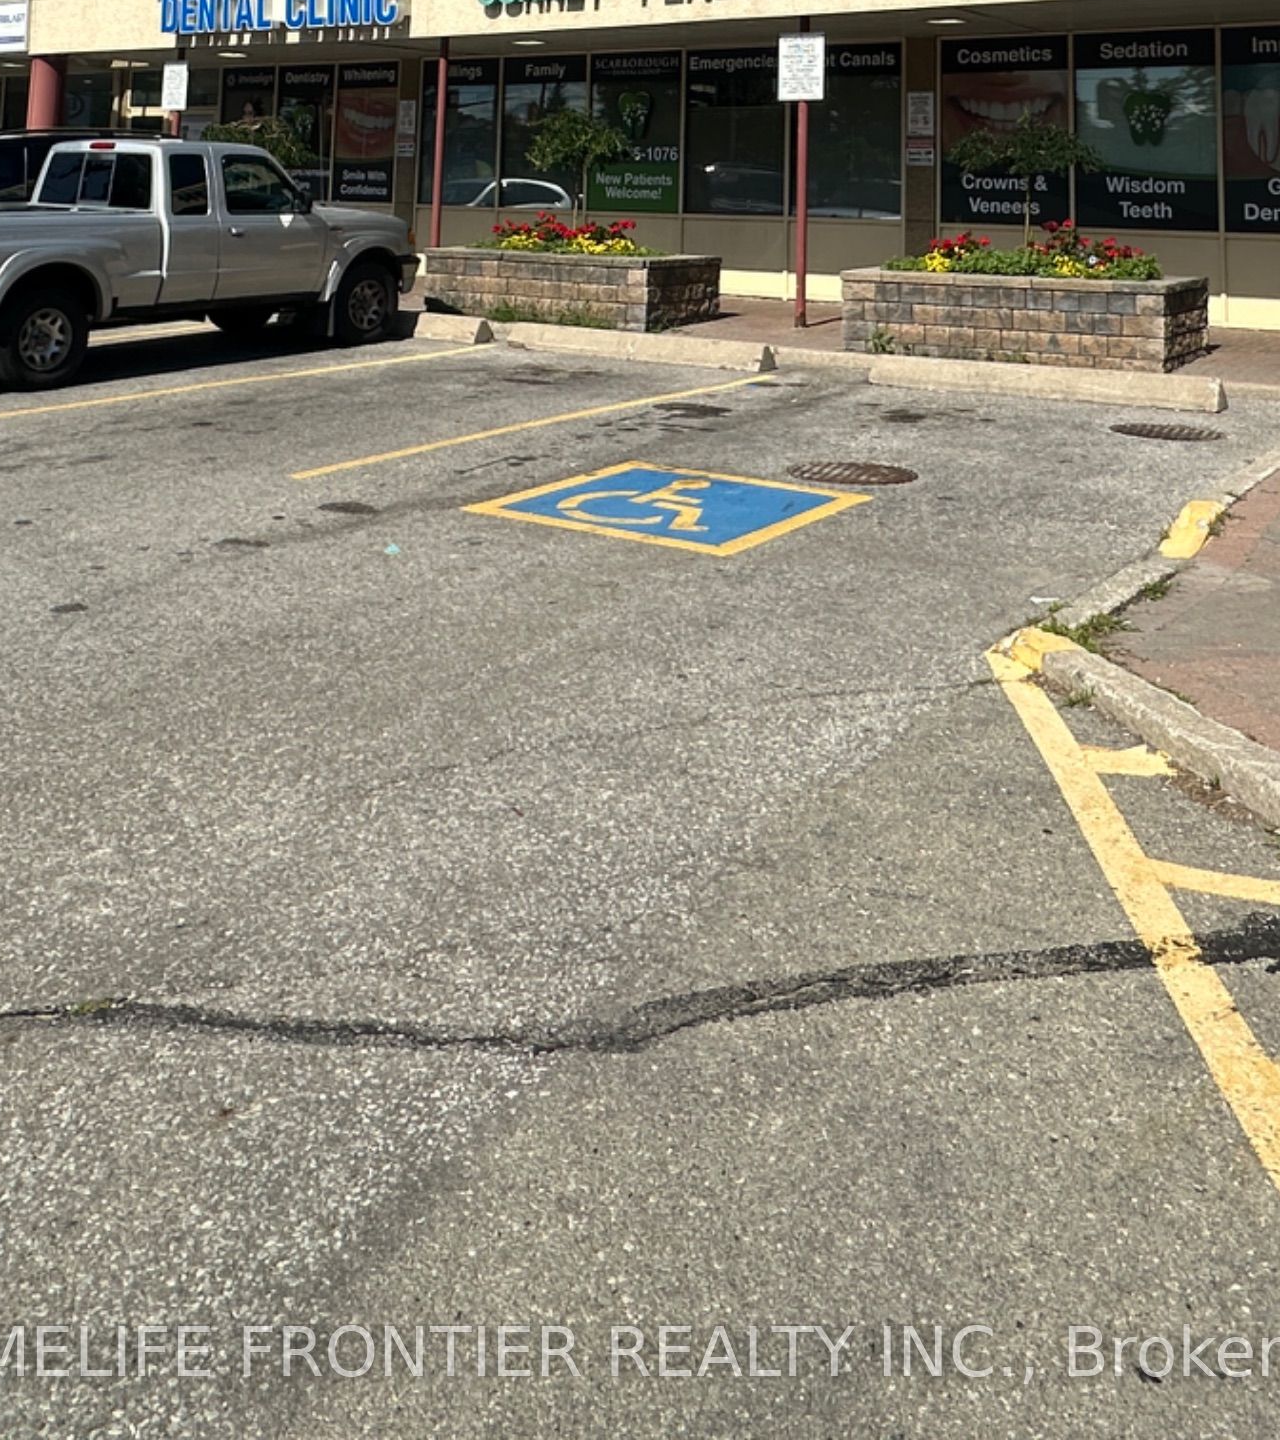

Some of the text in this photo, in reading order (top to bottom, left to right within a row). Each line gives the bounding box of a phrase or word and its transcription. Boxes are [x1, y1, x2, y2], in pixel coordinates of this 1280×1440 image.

[958, 47, 1053, 64] Cosmetics
[1100, 42, 1188, 59] Sedation
[689, 55, 778, 73] Emergencie
[840, 51, 896, 68] Canals
[285, 72, 330, 85] Dentistry
[344, 69, 395, 83] Whitening
[525, 63, 565, 78] Family
[596, 172, 673, 186] New Patients
[962, 174, 1048, 192] Crowns &
[1106, 175, 1186, 195] Wisdom
[340, 184, 388, 196] Confidence
[605, 185, 663, 200] Welcome!
[969, 198, 1040, 215] Veneers
[1118, 200, 1173, 220] Teeth
